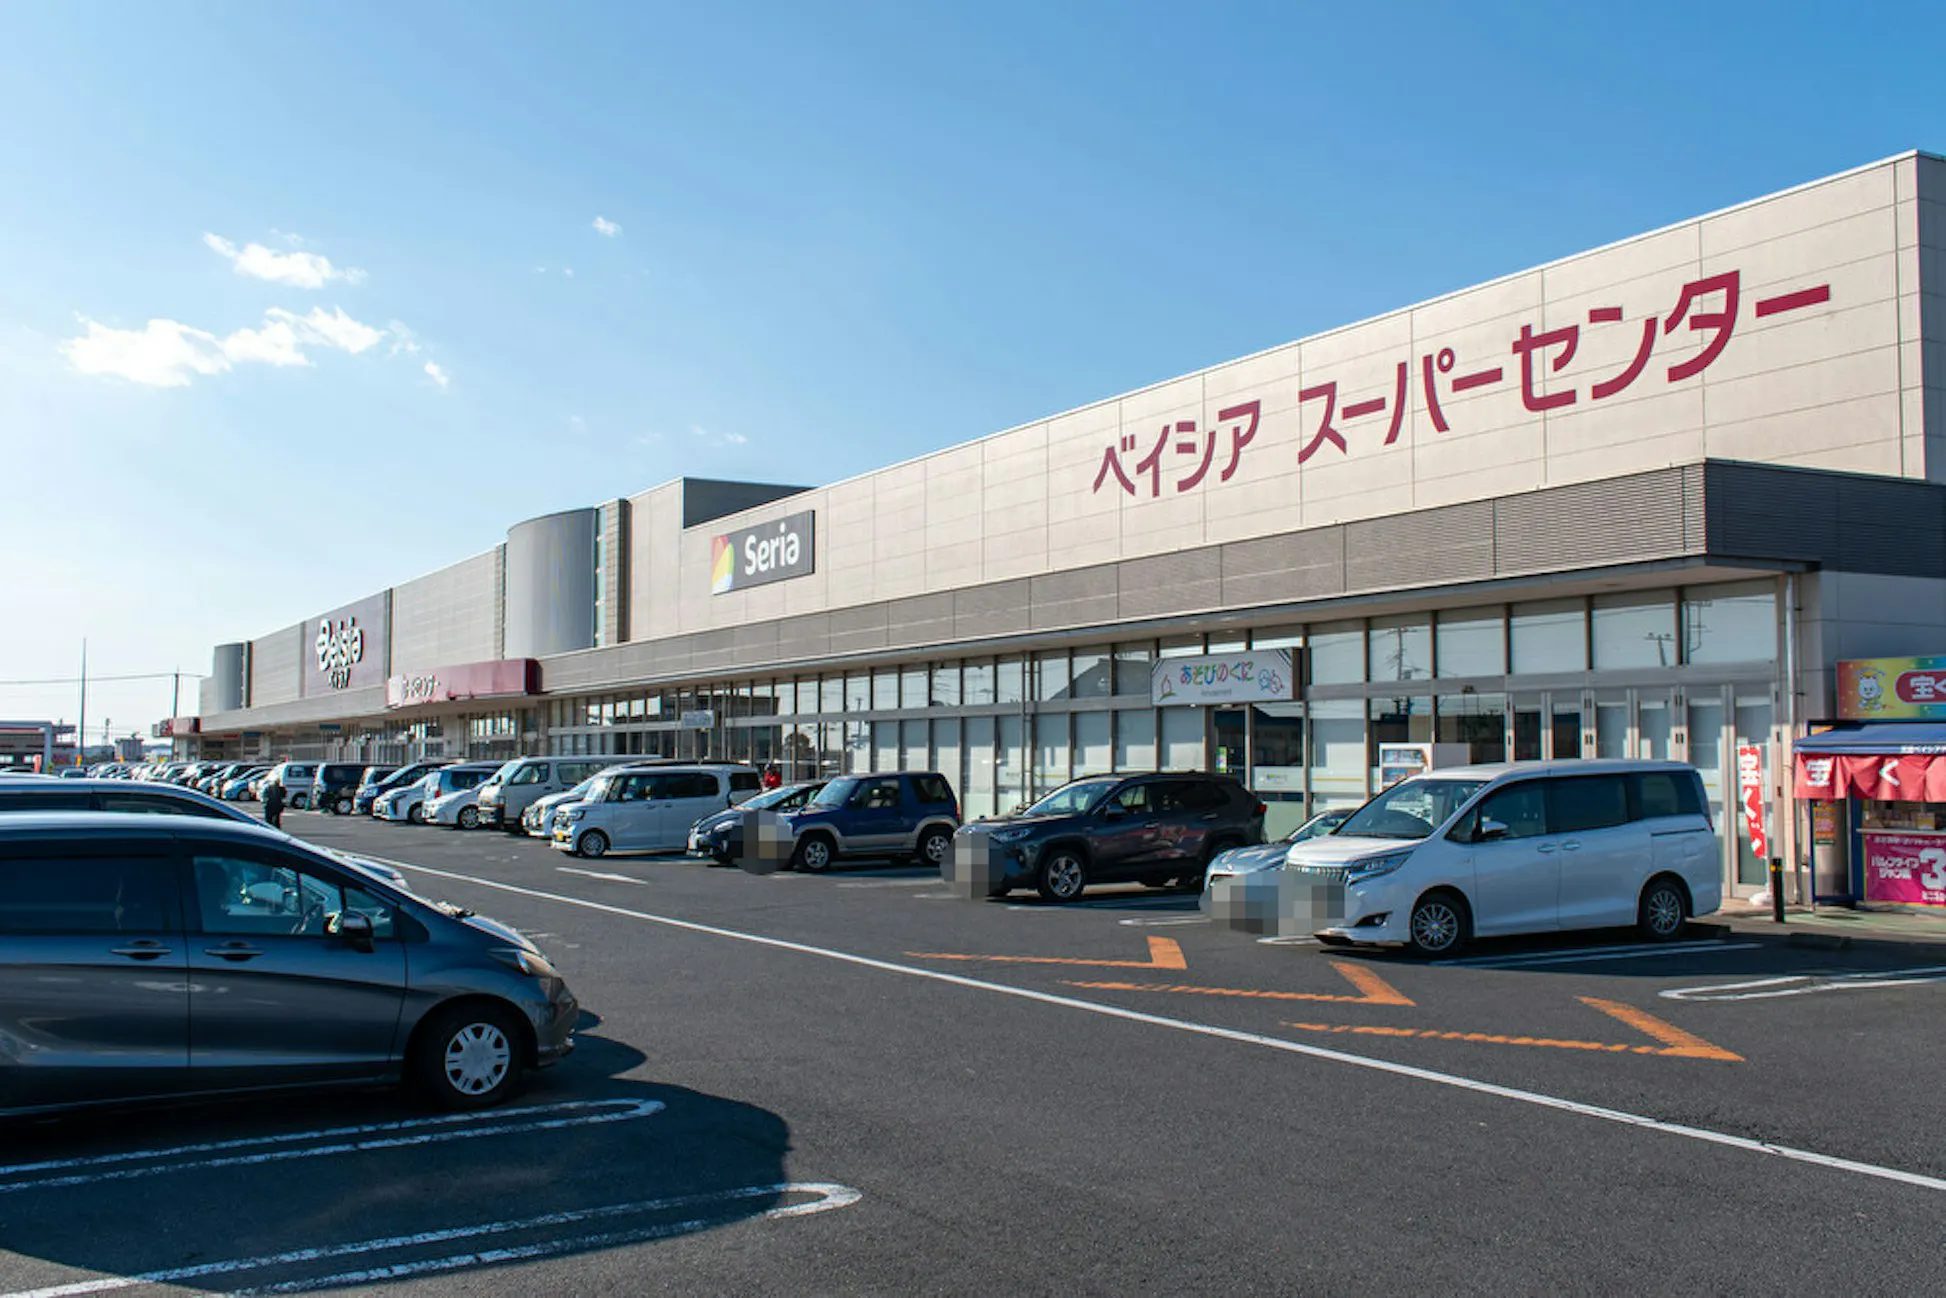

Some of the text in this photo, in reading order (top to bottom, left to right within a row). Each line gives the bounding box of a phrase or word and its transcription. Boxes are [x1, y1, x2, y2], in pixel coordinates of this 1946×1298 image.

[1093, 269, 1830, 498] ベイシア スーパーセンター
[744, 521, 800, 576] Seria
[315, 616, 363, 672] Beisia
[1180, 660, 1254, 685] あそびのくに
